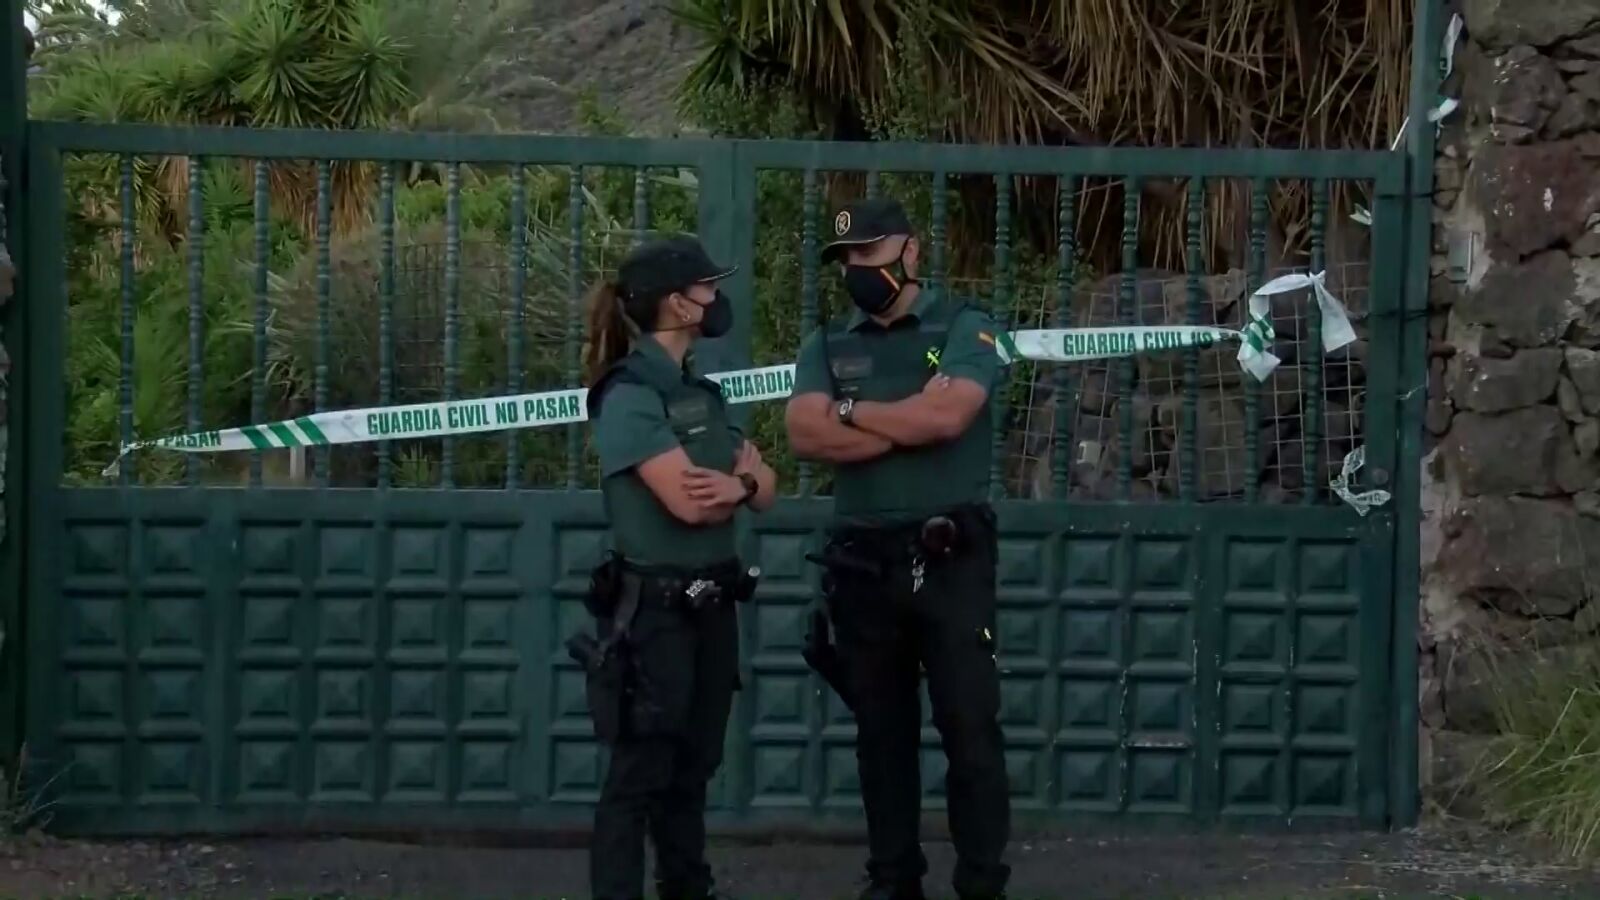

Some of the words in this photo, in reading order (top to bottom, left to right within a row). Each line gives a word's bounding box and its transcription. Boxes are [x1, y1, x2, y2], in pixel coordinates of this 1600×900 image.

[1063, 332, 1136, 356] GUARDIA
[720, 370, 794, 399] GUARDIA
[367, 408, 441, 435] GUARDIA
[447, 404, 490, 428] CIVIL
[496, 401, 518, 424] NO
[524, 395, 580, 421] PASAR
